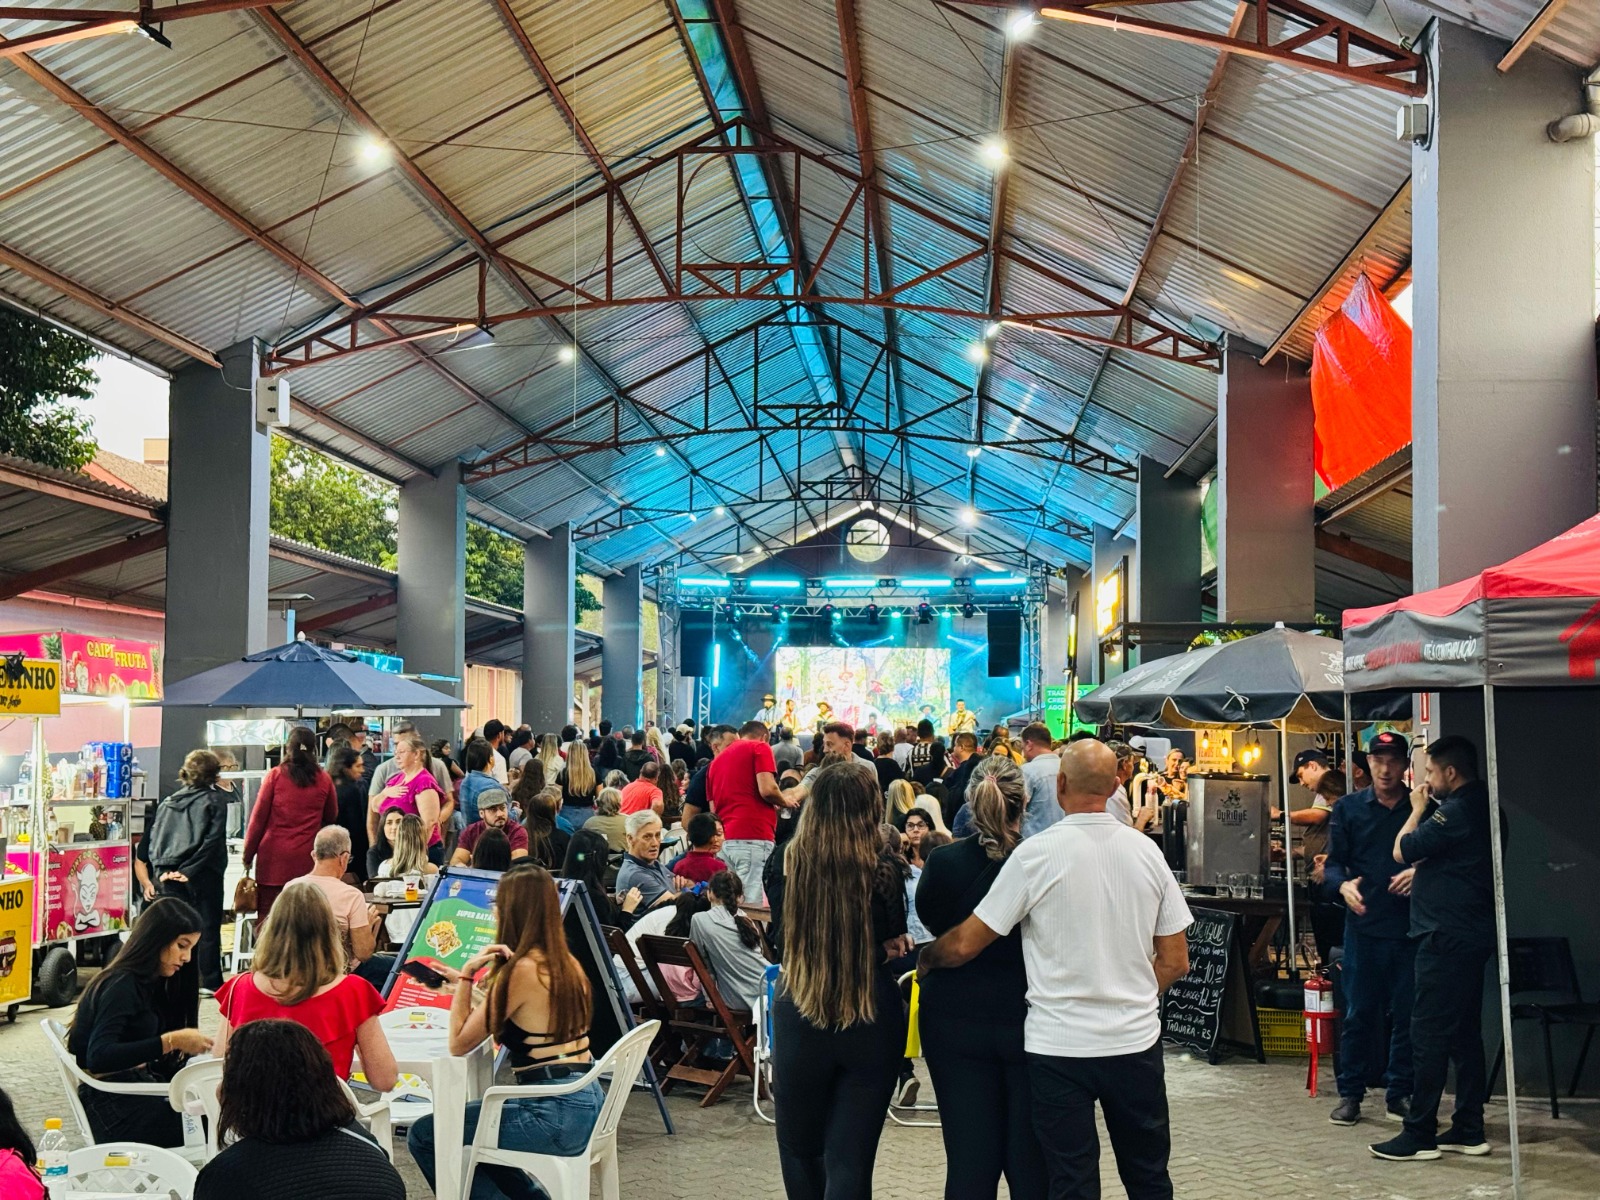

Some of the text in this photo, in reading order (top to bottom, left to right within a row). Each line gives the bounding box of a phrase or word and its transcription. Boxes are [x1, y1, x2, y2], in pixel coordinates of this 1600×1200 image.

[87, 641, 148, 670] CAIPI FRUTA
[456, 909, 476, 919] SUPER
[1166, 1019, 1196, 1038] TAQUARA
[1201, 1028, 1212, 1040] RS
